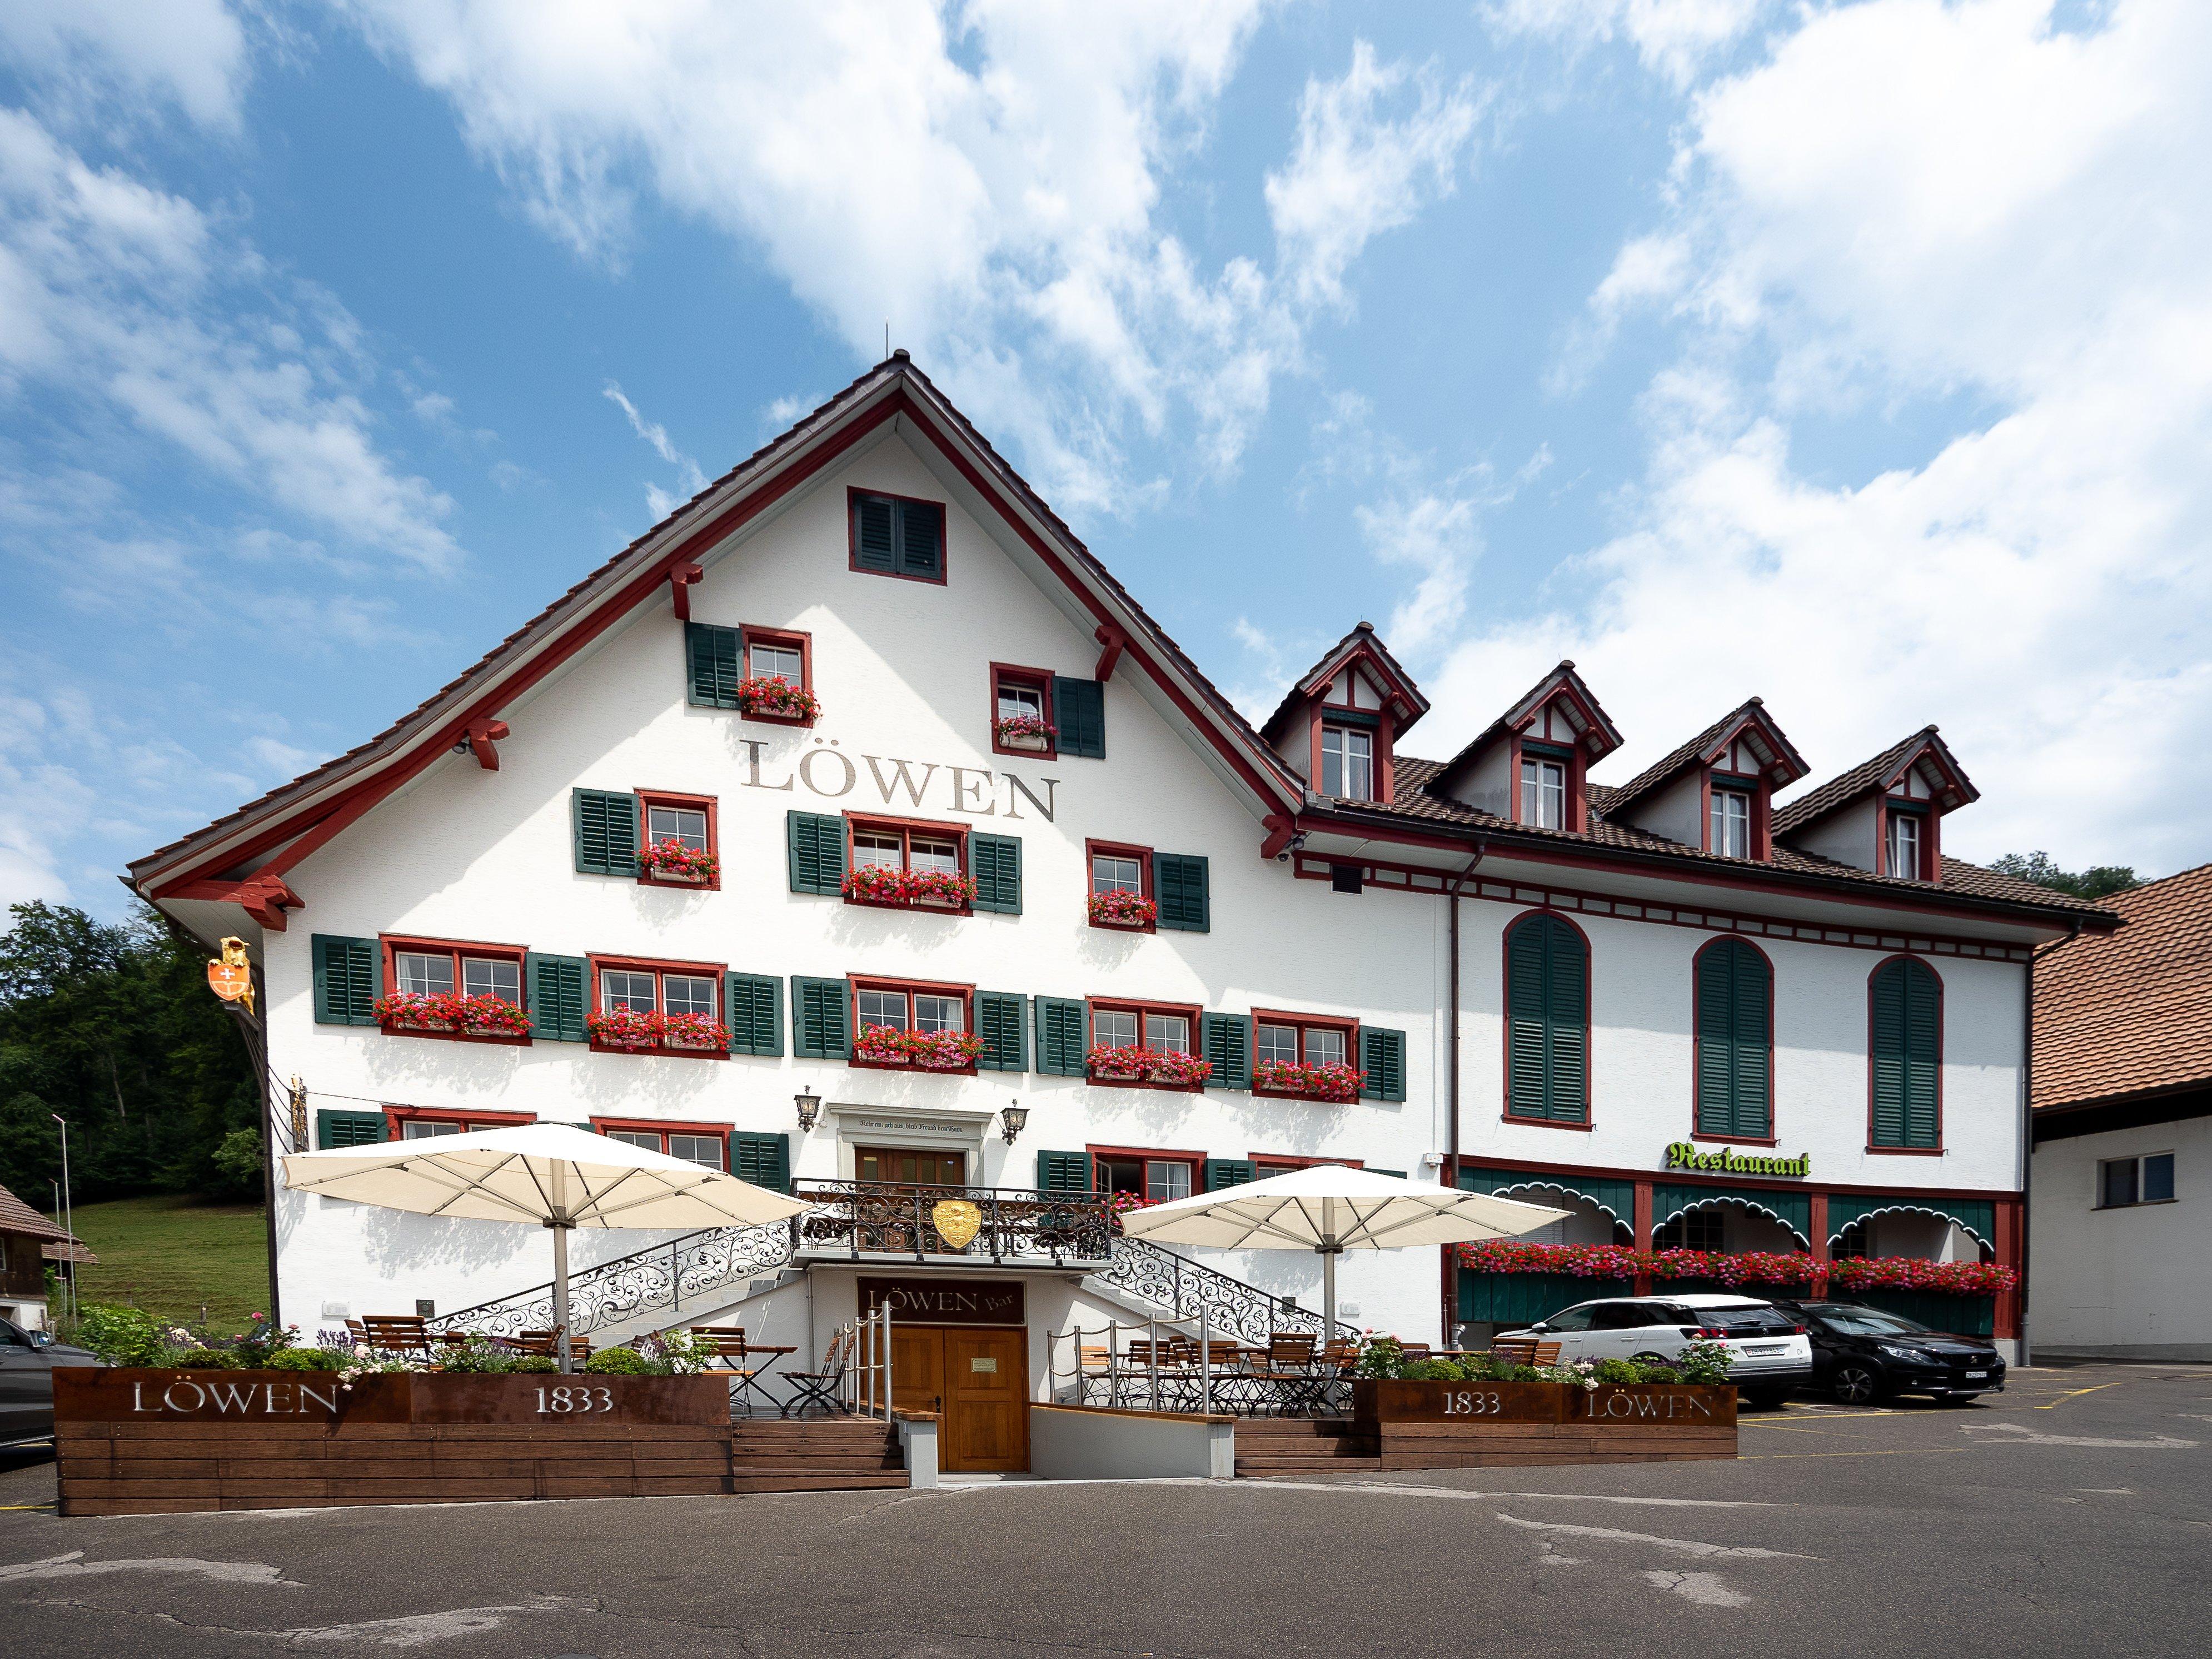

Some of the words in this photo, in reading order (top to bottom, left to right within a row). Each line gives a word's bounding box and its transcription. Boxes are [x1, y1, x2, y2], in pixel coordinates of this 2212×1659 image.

[739, 738, 1060, 823] LÖWEN
[1666, 1142, 1811, 1177] Restaurant
[869, 1287, 978, 1311] LÖWEN
[985, 1293, 1014, 1311] Bar
[133, 1375, 338, 1413] LÖWEN
[534, 1386, 613, 1413] 1833
[1443, 1391, 1502, 1414] 1833
[1587, 1389, 1712, 1419] LÖWEN
